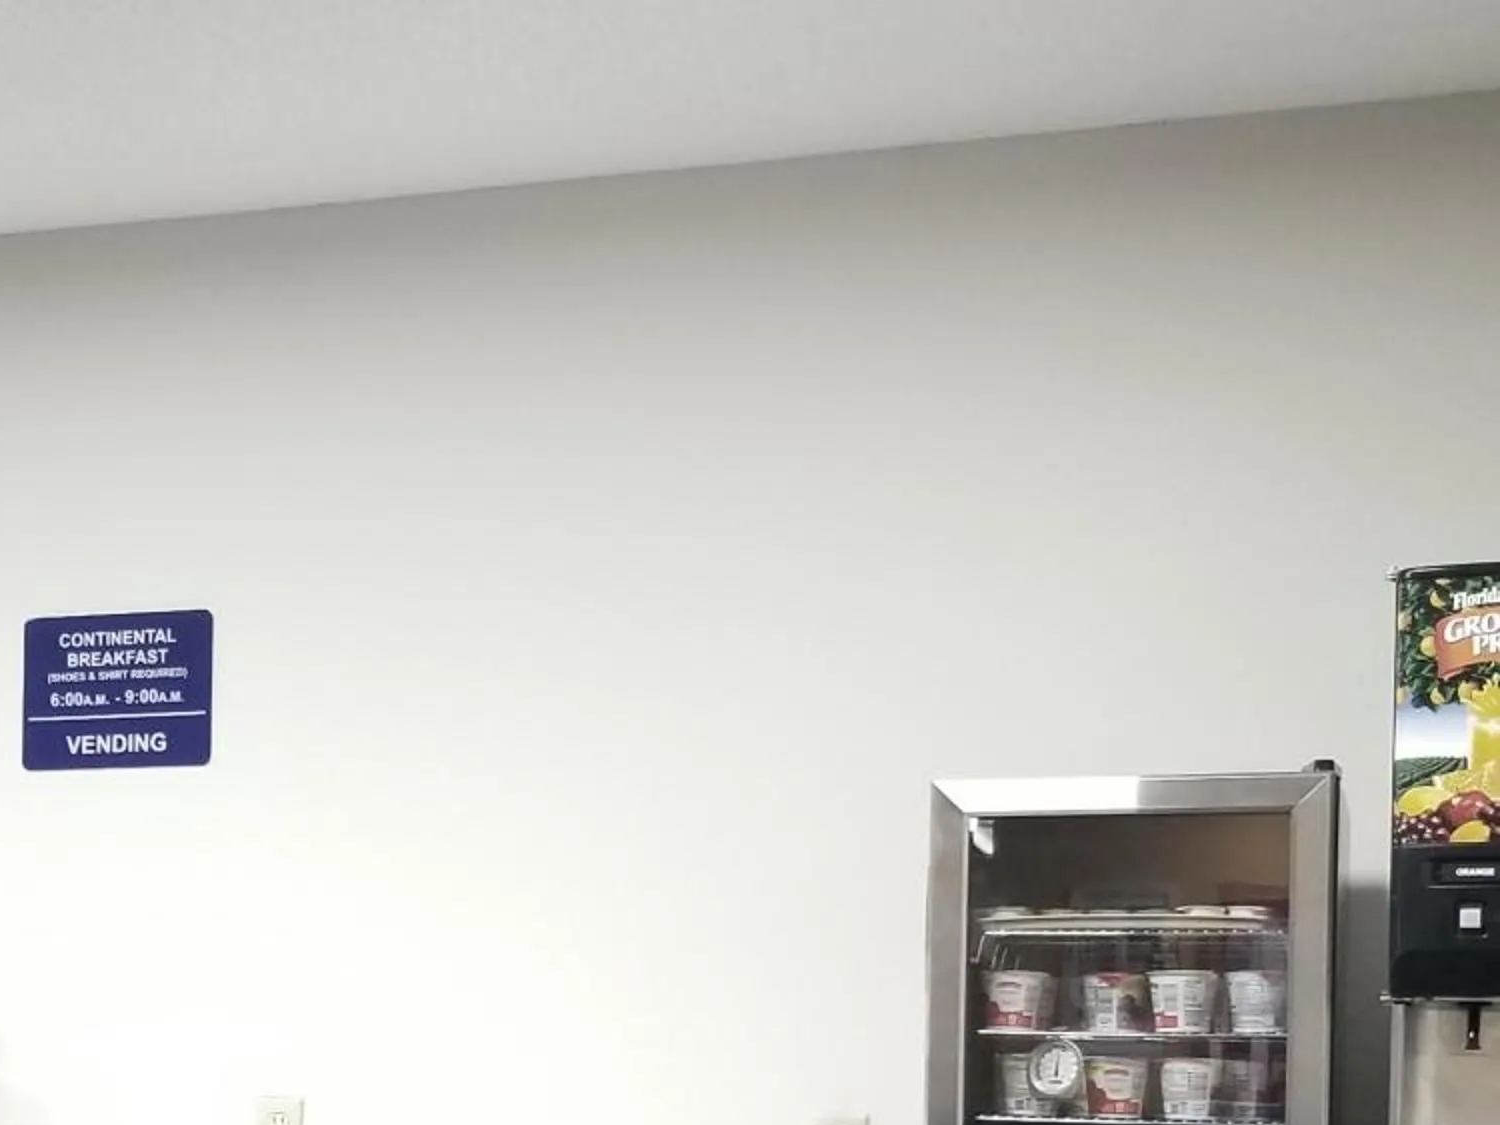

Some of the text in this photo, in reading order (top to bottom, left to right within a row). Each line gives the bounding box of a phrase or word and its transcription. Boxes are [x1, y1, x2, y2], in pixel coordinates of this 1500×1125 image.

[59, 628, 177, 648] CONTINENTAL
[67, 648, 169, 668] BREAKFAST
[47, 667, 188, 684] (SHOES & SHIRT REQUIRED)
[65, 731, 168, 755] VENDING
